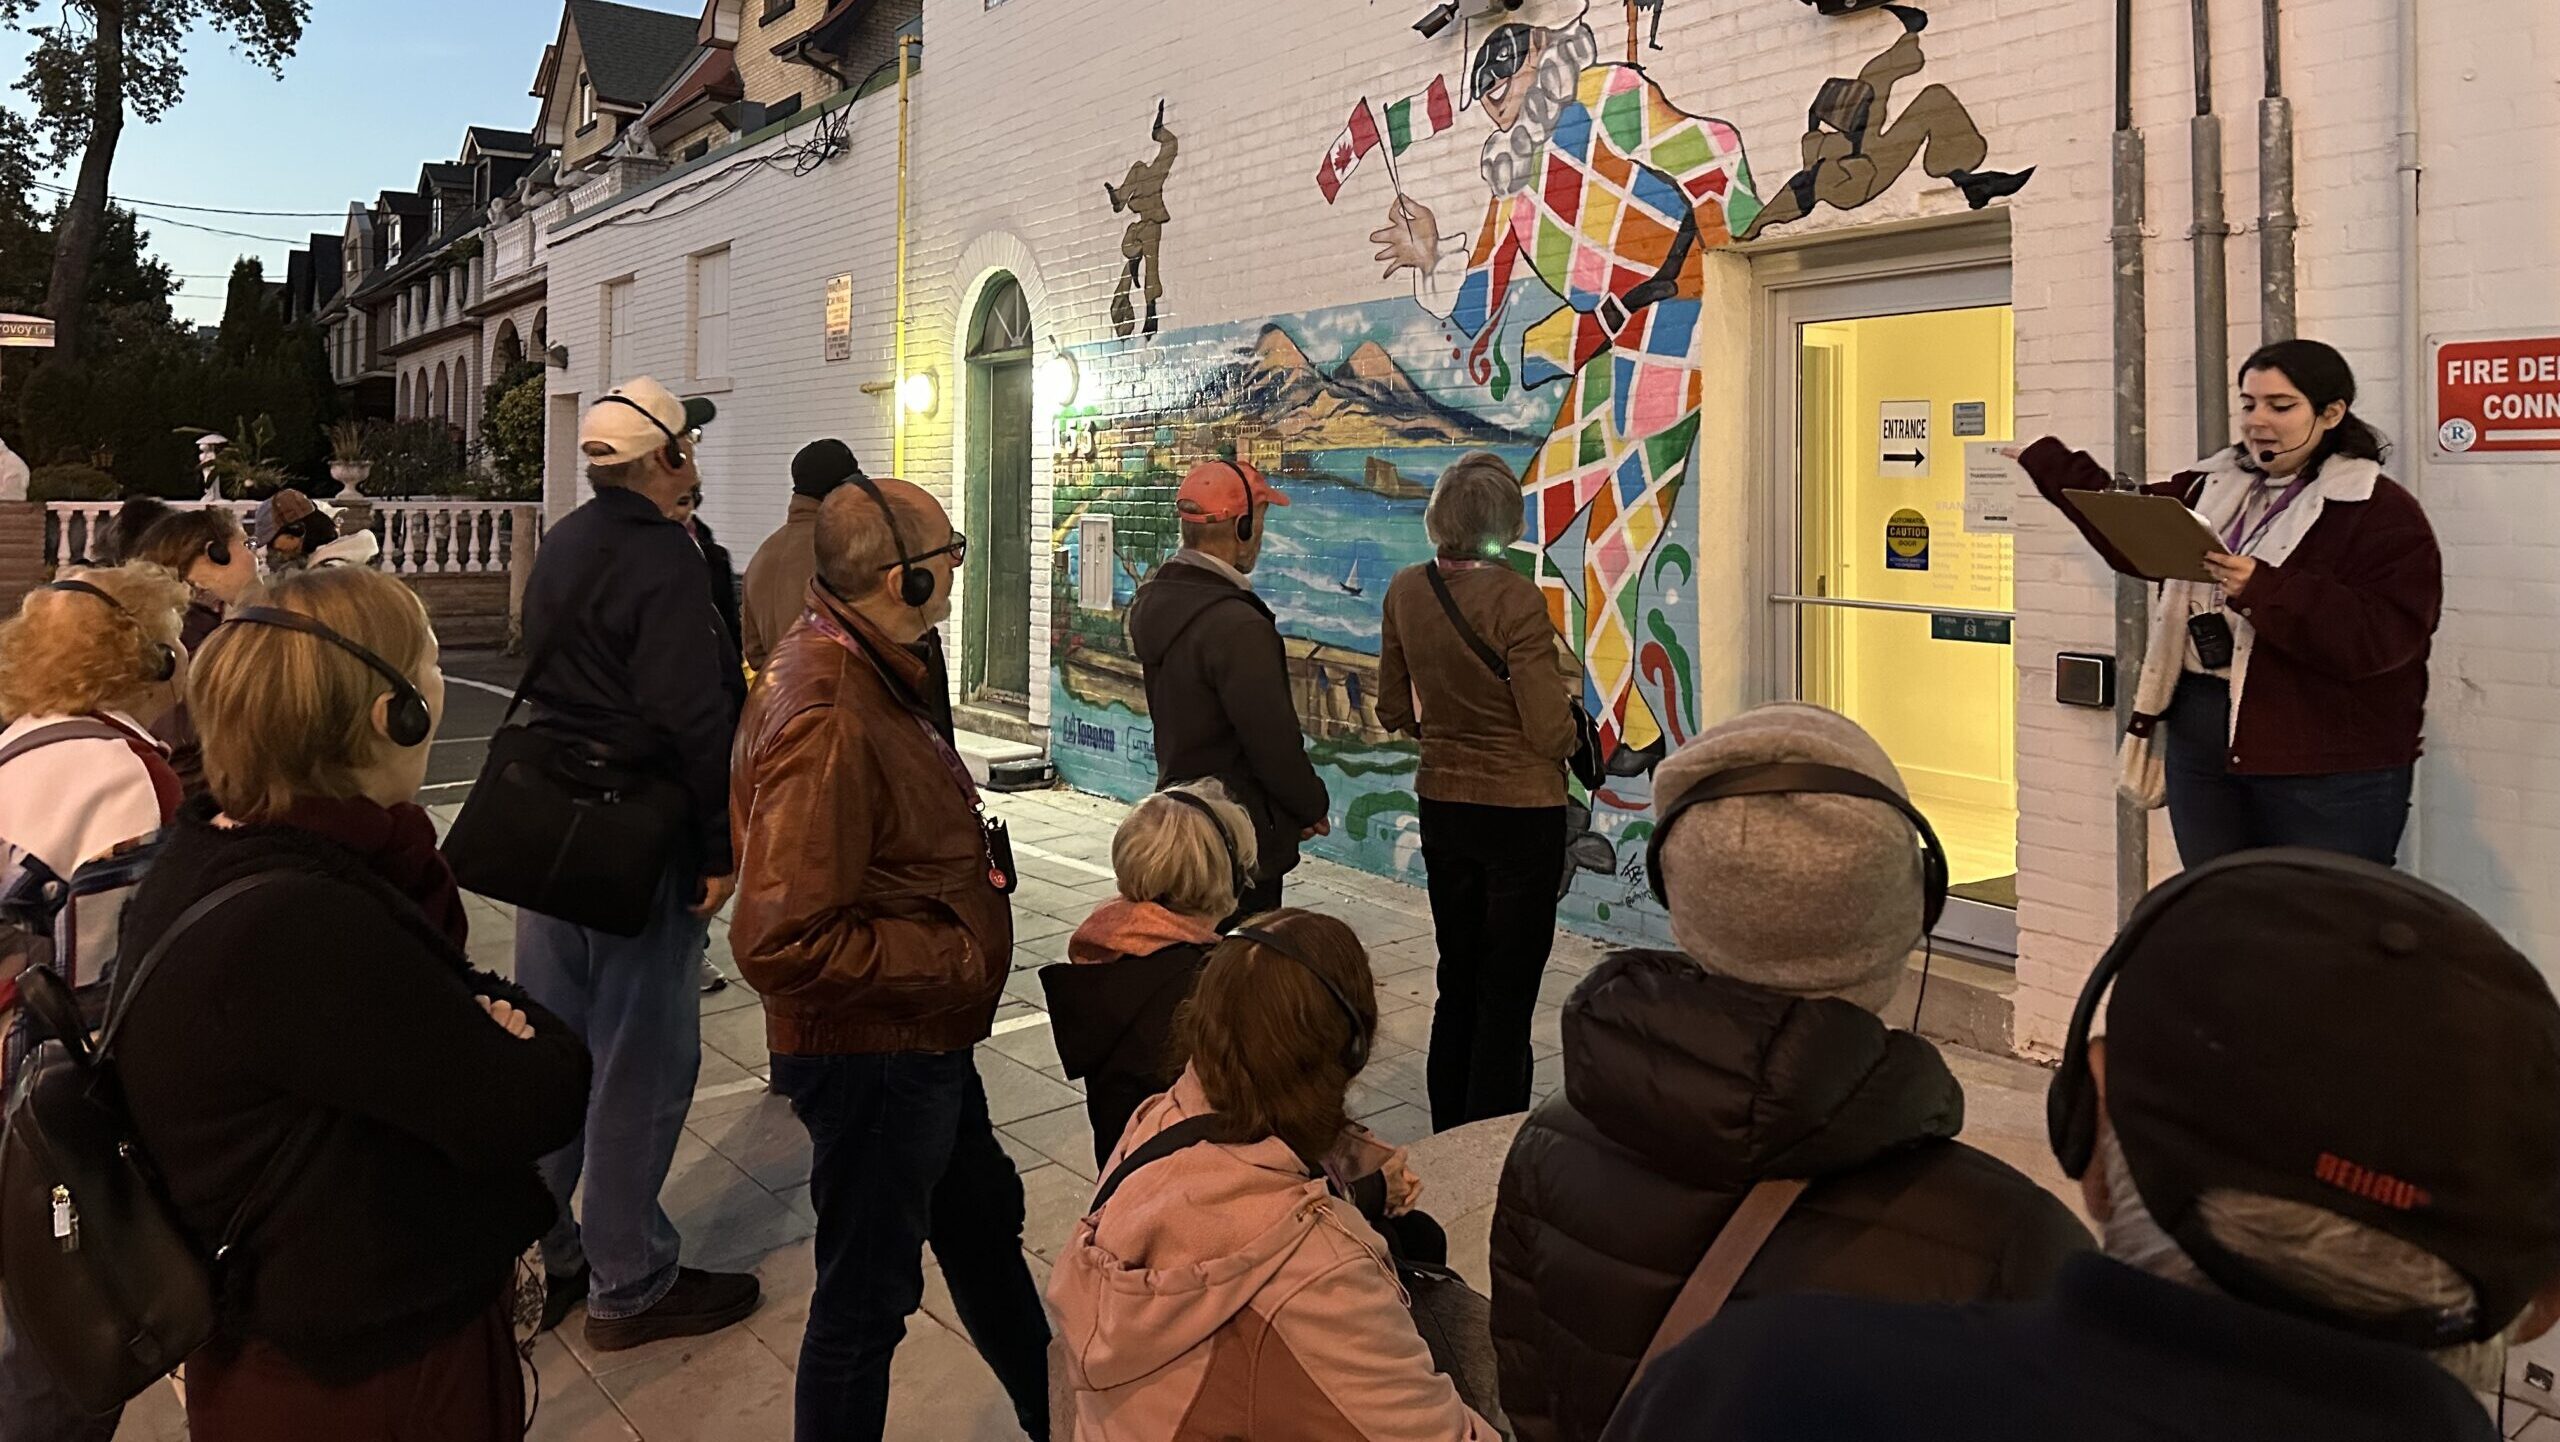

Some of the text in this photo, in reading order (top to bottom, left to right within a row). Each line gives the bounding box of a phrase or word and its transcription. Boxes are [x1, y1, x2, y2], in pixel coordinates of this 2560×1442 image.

[0, 324, 32, 337] ovoy
[2447, 355, 2560, 385] FIRE DE
[1883, 418, 1926, 439] ENTRANCE
[2452, 426, 2465, 440] R
[1890, 526, 1927, 538] CAUTION
[1077, 717, 1116, 753] TORONTO
